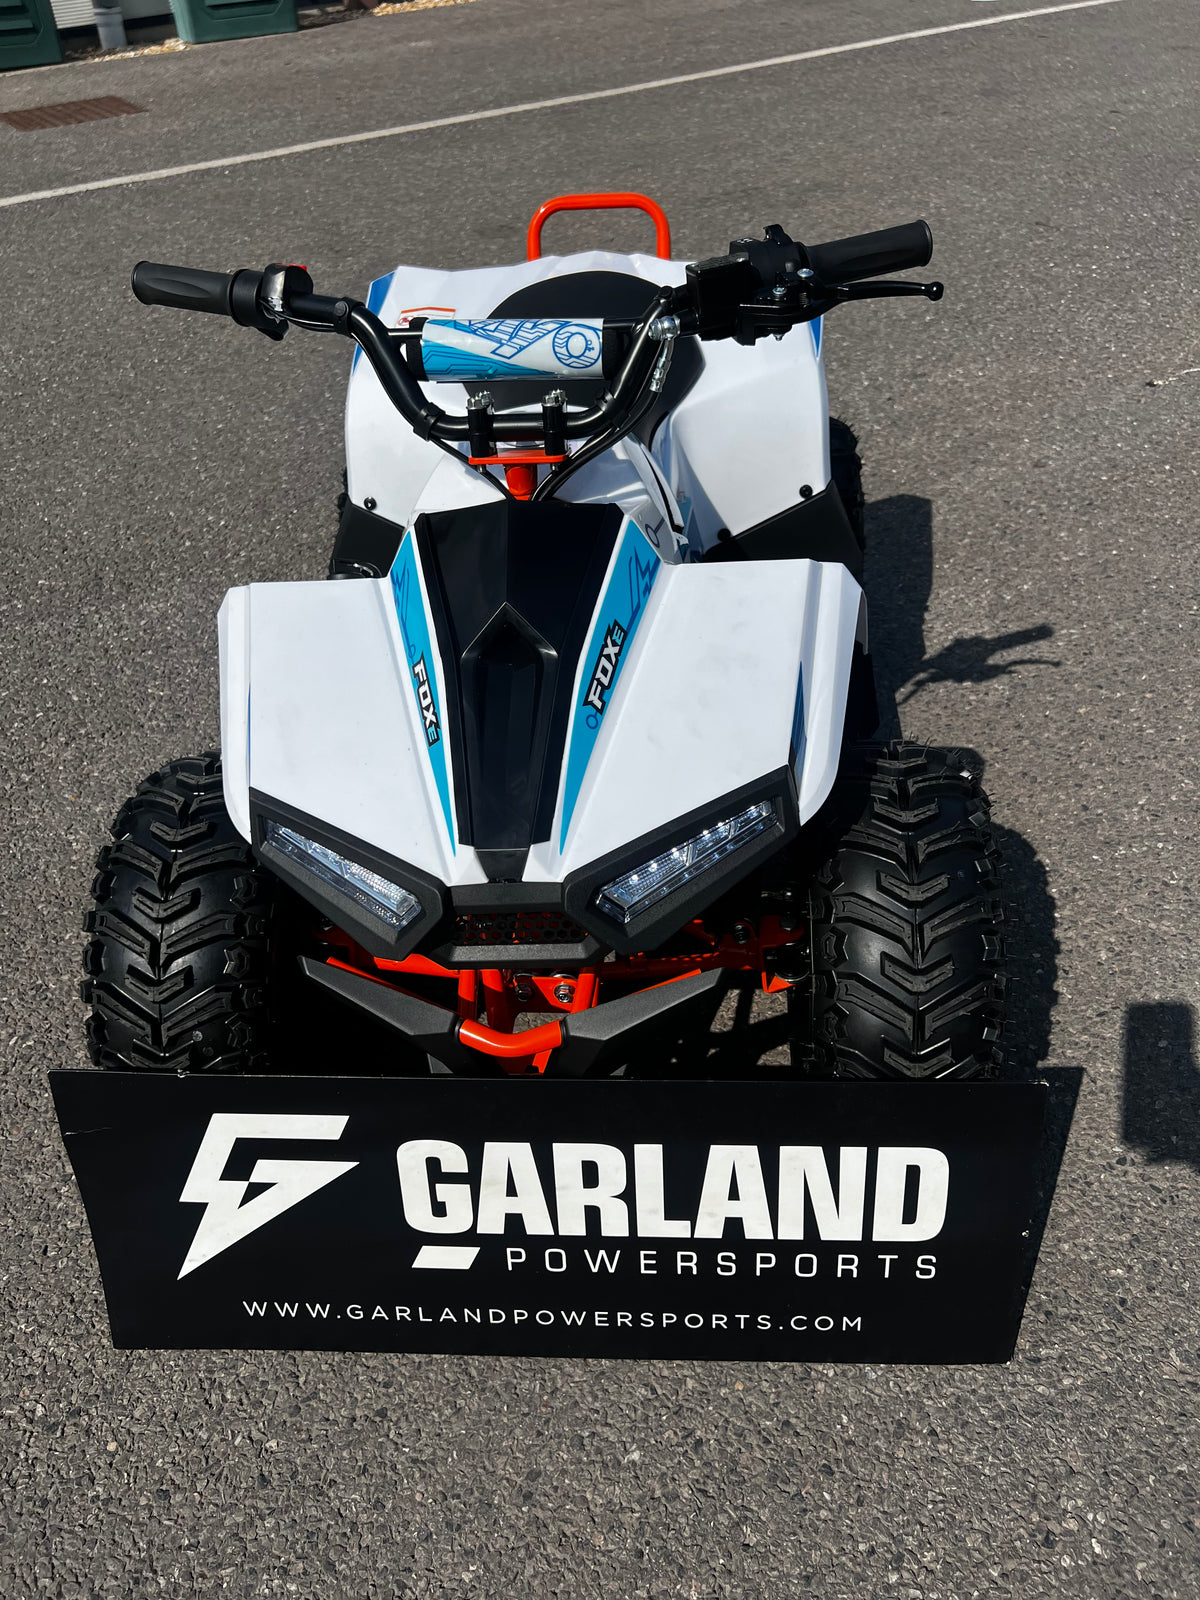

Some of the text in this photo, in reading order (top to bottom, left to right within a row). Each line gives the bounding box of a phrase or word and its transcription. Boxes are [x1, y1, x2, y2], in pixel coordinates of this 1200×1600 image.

[396, 1139, 950, 1242] GARLAND
[506, 1247, 938, 1280] POWERSPORTS
[242, 1301, 864, 1333] WWW.GARLANDPOWERSPORTS.COM
